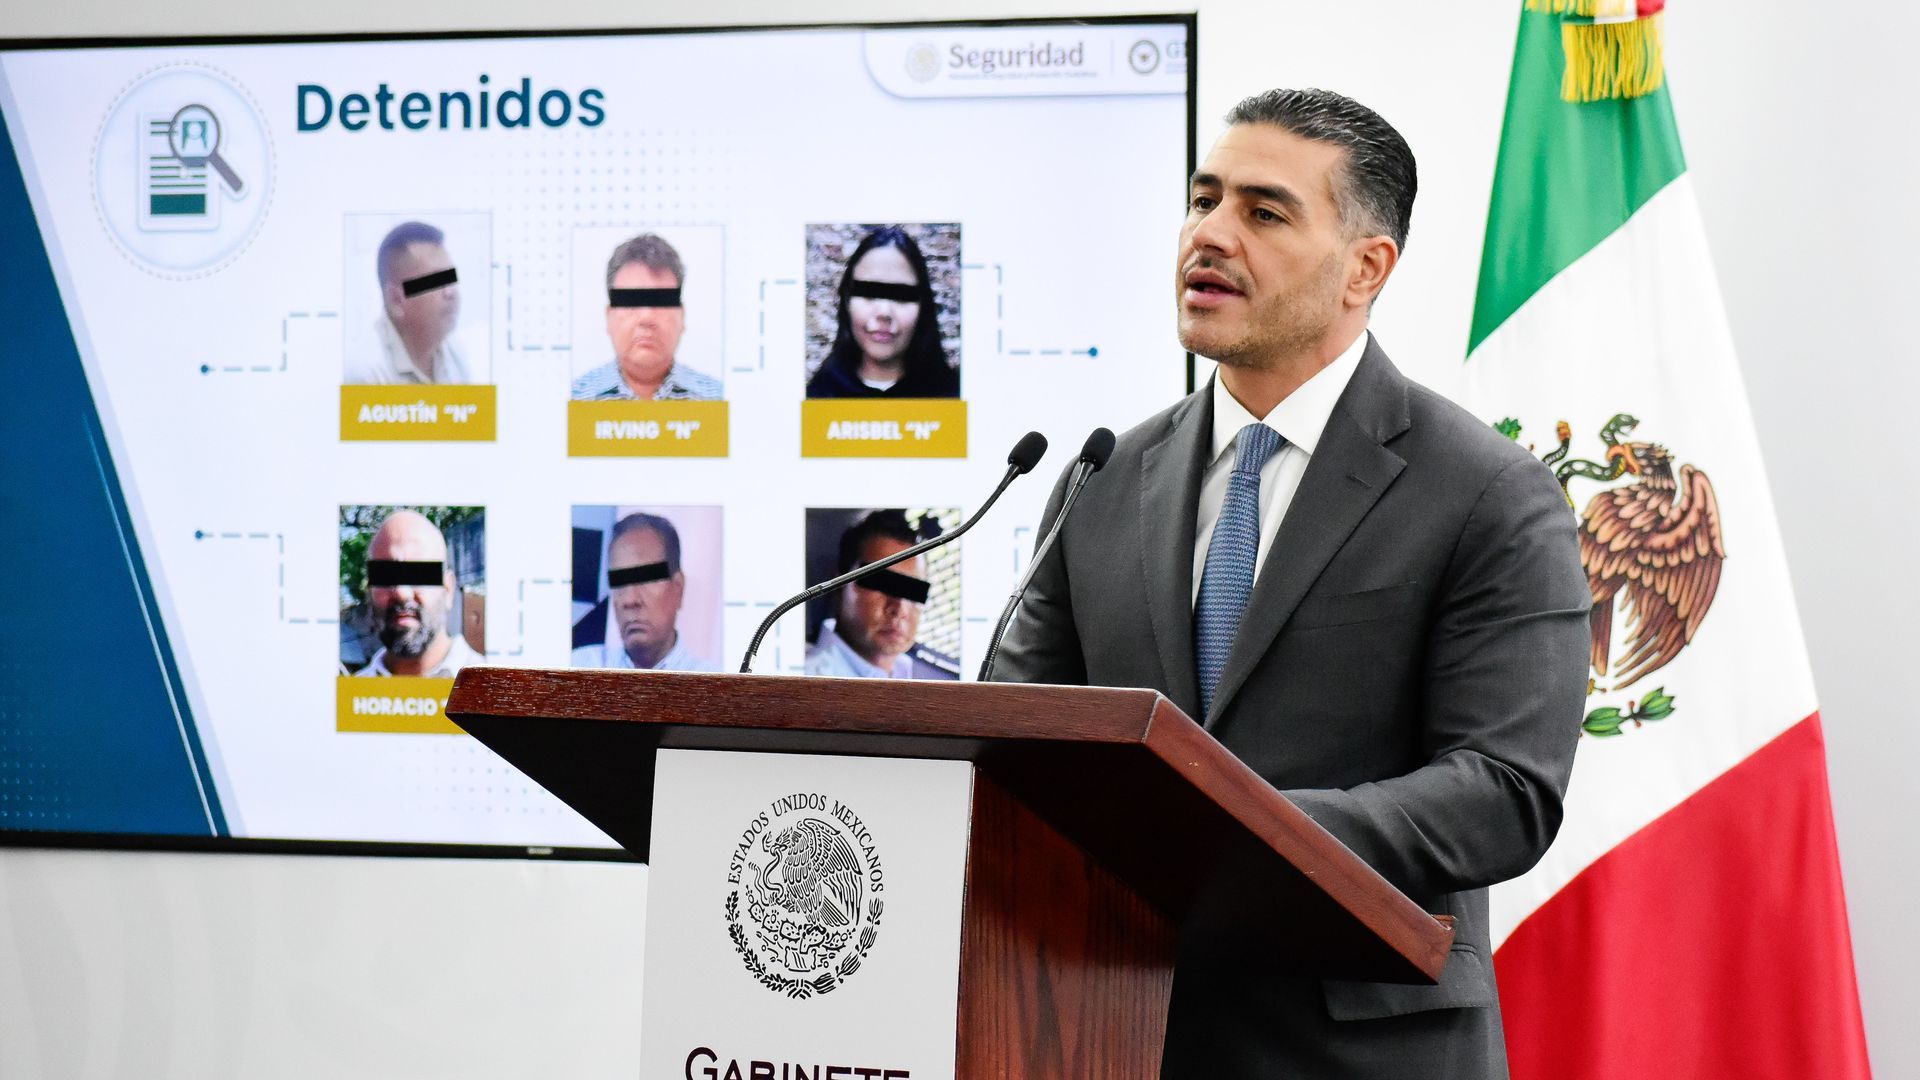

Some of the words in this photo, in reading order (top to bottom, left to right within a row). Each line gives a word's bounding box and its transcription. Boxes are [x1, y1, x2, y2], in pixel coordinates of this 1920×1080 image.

[949, 41, 1084, 73] Seguridad
[1165, 40, 1187, 60] G
[297, 74, 606, 131] Detenidos
[358, 400, 438, 423] AGUSTÍN
[595, 420, 660, 440] IRVING
[827, 420, 903, 440] ARISBEL
[352, 696, 438, 717] HORACIO
[727, 811, 769, 885] ESTADOS
[771, 793, 827, 817] UNIDOS
[830, 800, 884, 893] MEXICANOS
